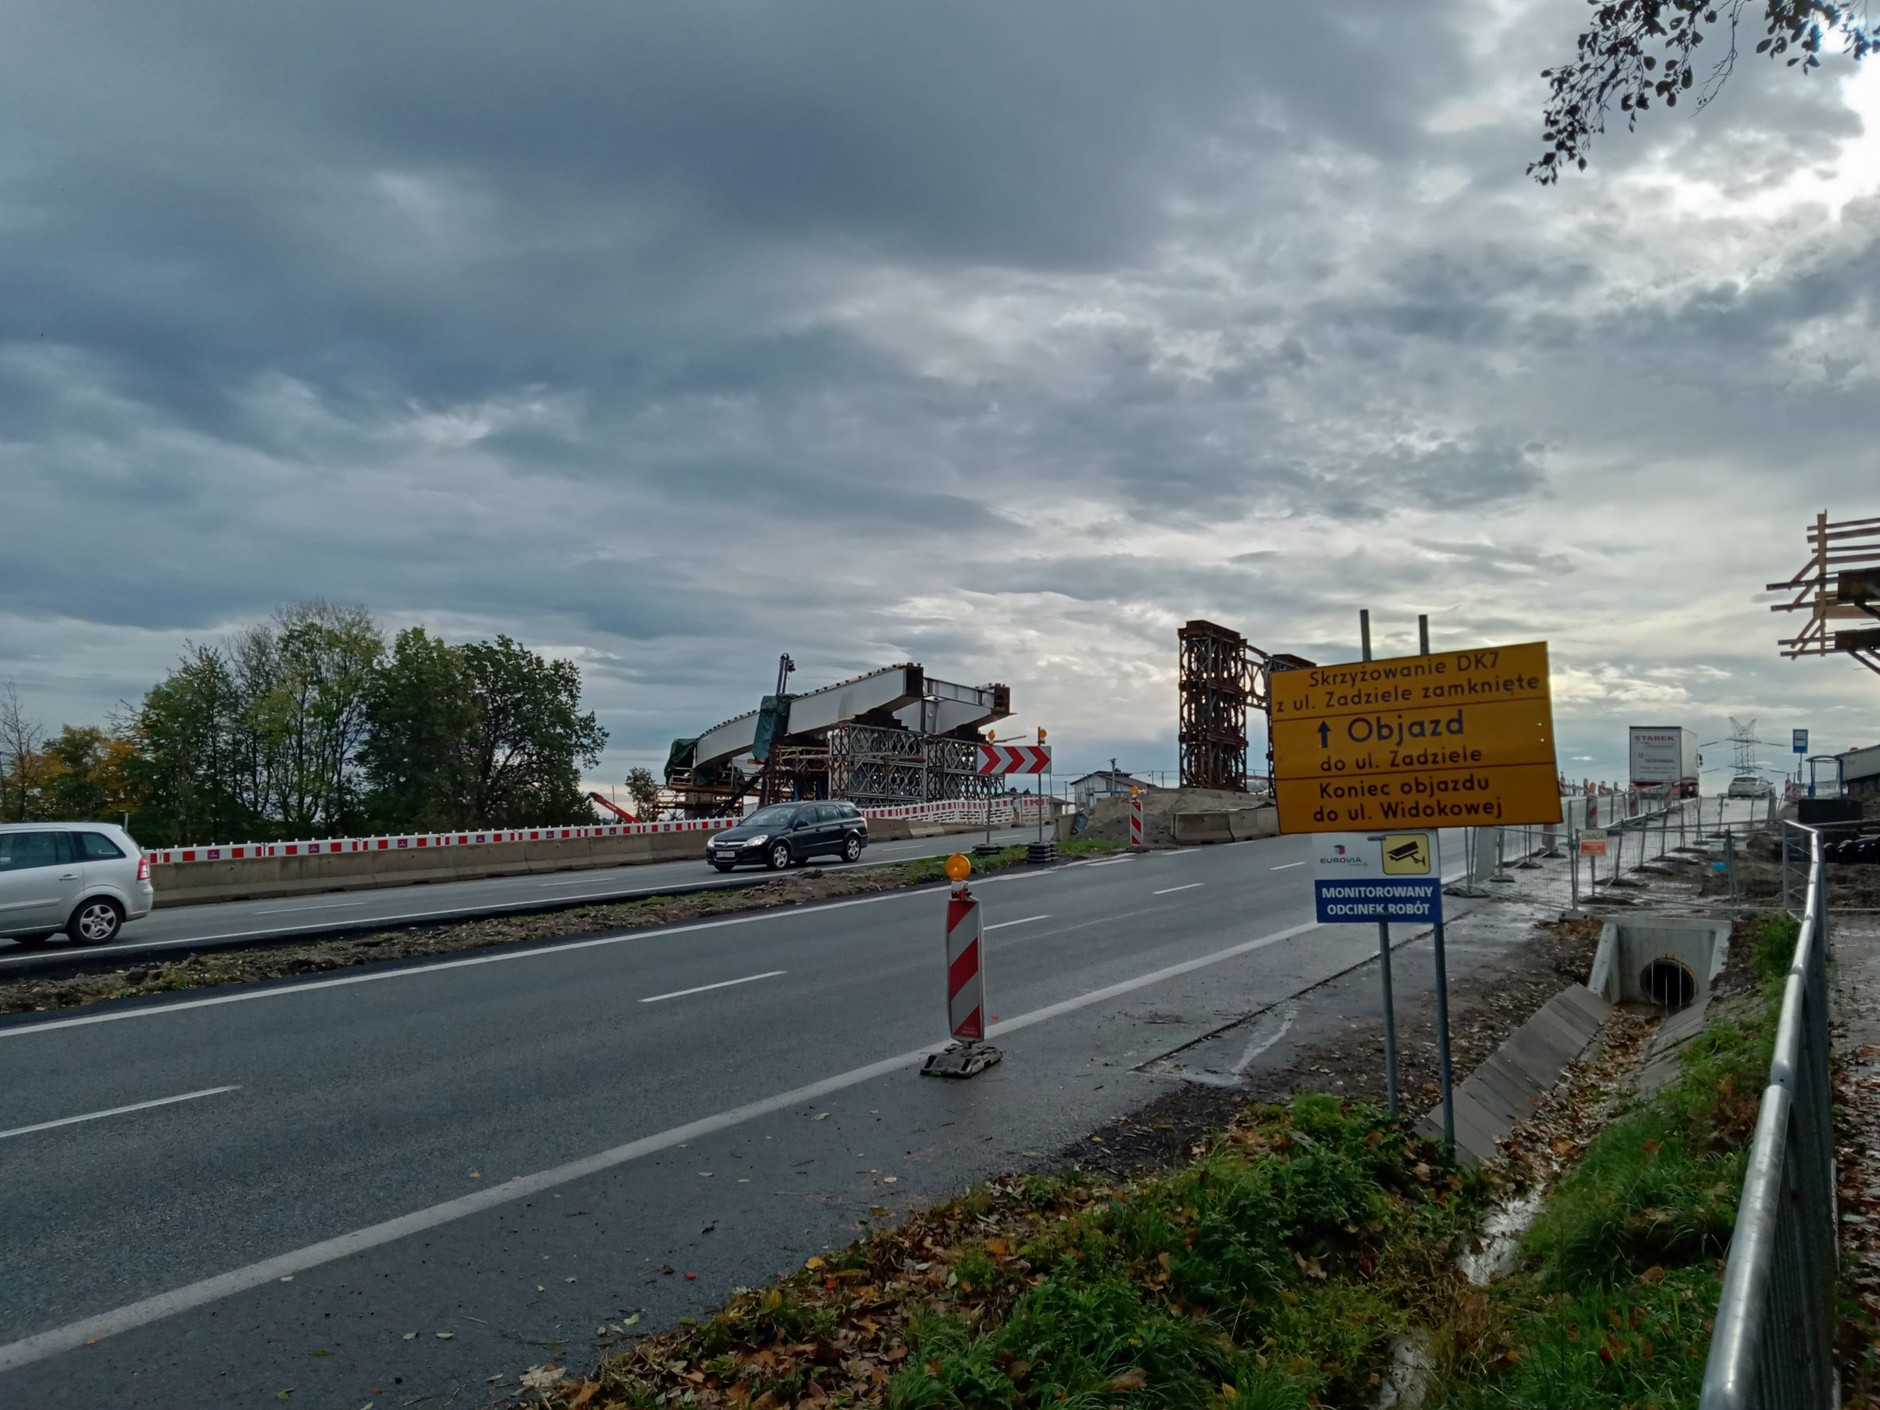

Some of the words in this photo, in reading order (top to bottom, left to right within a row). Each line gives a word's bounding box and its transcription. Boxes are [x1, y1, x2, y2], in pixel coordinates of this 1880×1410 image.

[1308, 659, 1447, 688] Skrzyżowanie
[1456, 651, 1499, 672] DK7
[1276, 701, 1285, 712] z
[1292, 694, 1316, 711] ul.
[1324, 684, 1413, 709] Zadziele
[1421, 674, 1540, 699] zamknięte
[1347, 709, 1464, 748] Objazd
[1320, 755, 1346, 772] do
[1355, 752, 1380, 770] ul.
[1388, 745, 1482, 768] Zadziele
[1319, 780, 1391, 799] Koniec
[1400, 773, 1489, 798] objazdu
[1313, 806, 1339, 822] do
[1348, 803, 1373, 821] ul.
[1380, 796, 1503, 819] Widokowej
[1320, 856, 1362, 865] EUROVIA
[1321, 886, 1433, 899] MONITOROWANY
[1326, 903, 1385, 916] ODCINEK
[1387, 901, 1431, 916] ROBÓT
